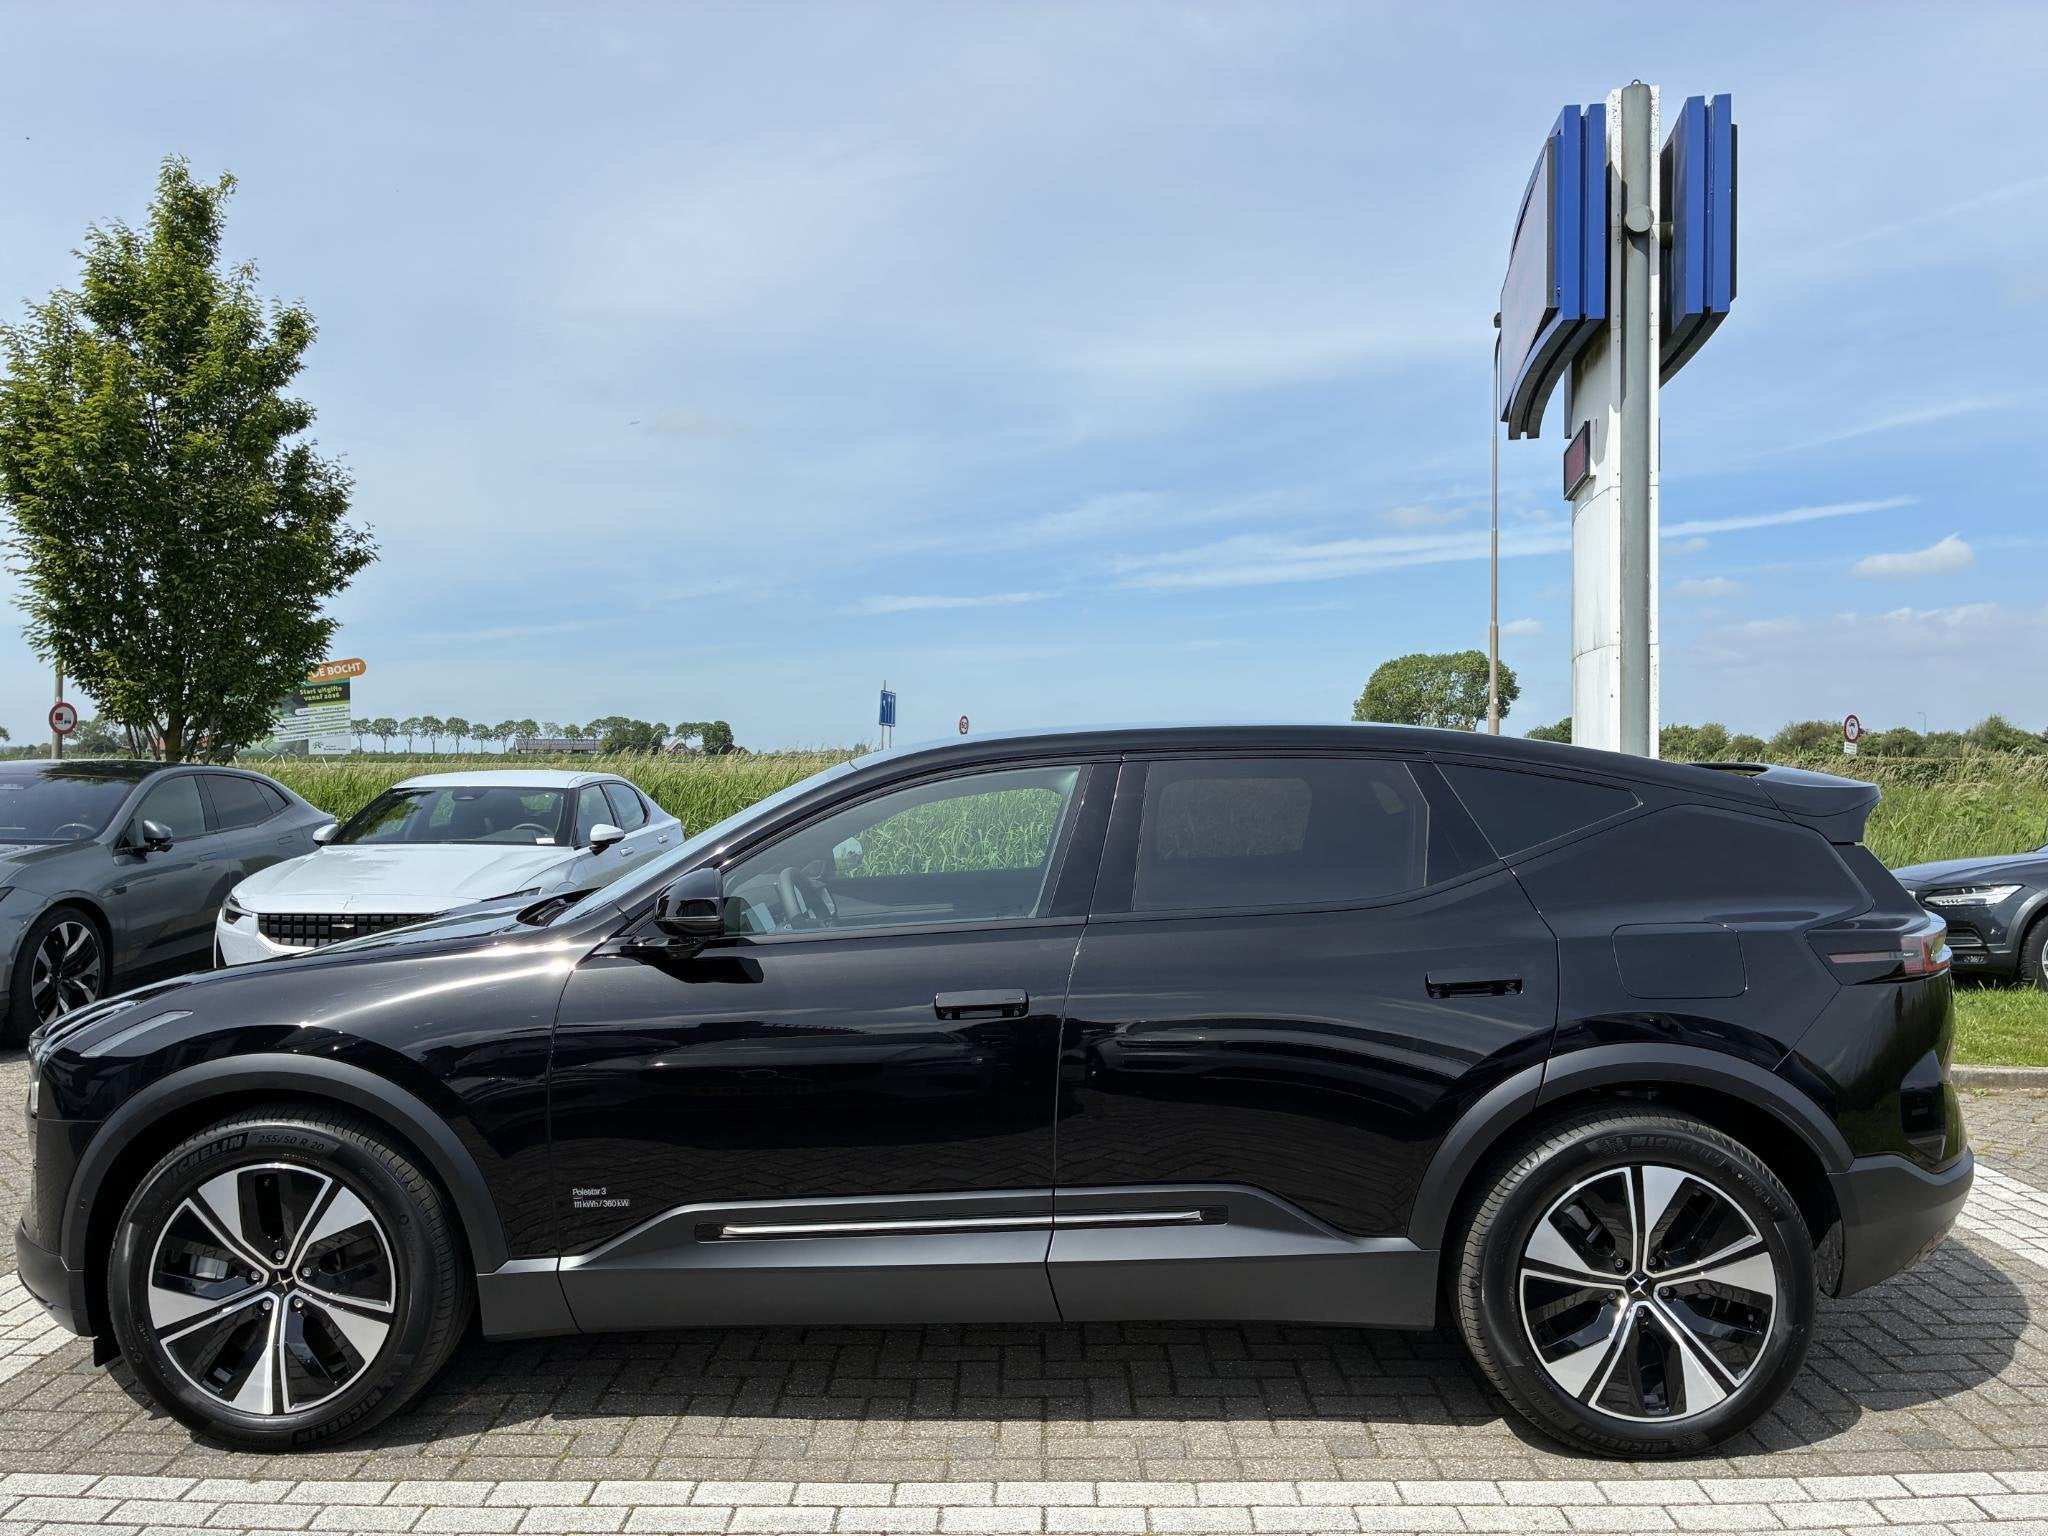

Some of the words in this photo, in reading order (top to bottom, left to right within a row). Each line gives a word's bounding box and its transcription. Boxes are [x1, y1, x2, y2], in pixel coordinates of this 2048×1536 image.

[327, 663, 360, 675] BOCHT
[257, 1134, 297, 1144] 255/50
[300, 1137, 309, 1146] R
[310, 1141, 325, 1150] 20
[572, 1187, 600, 1196] Polestar
[601, 1187, 606, 1195] 3
